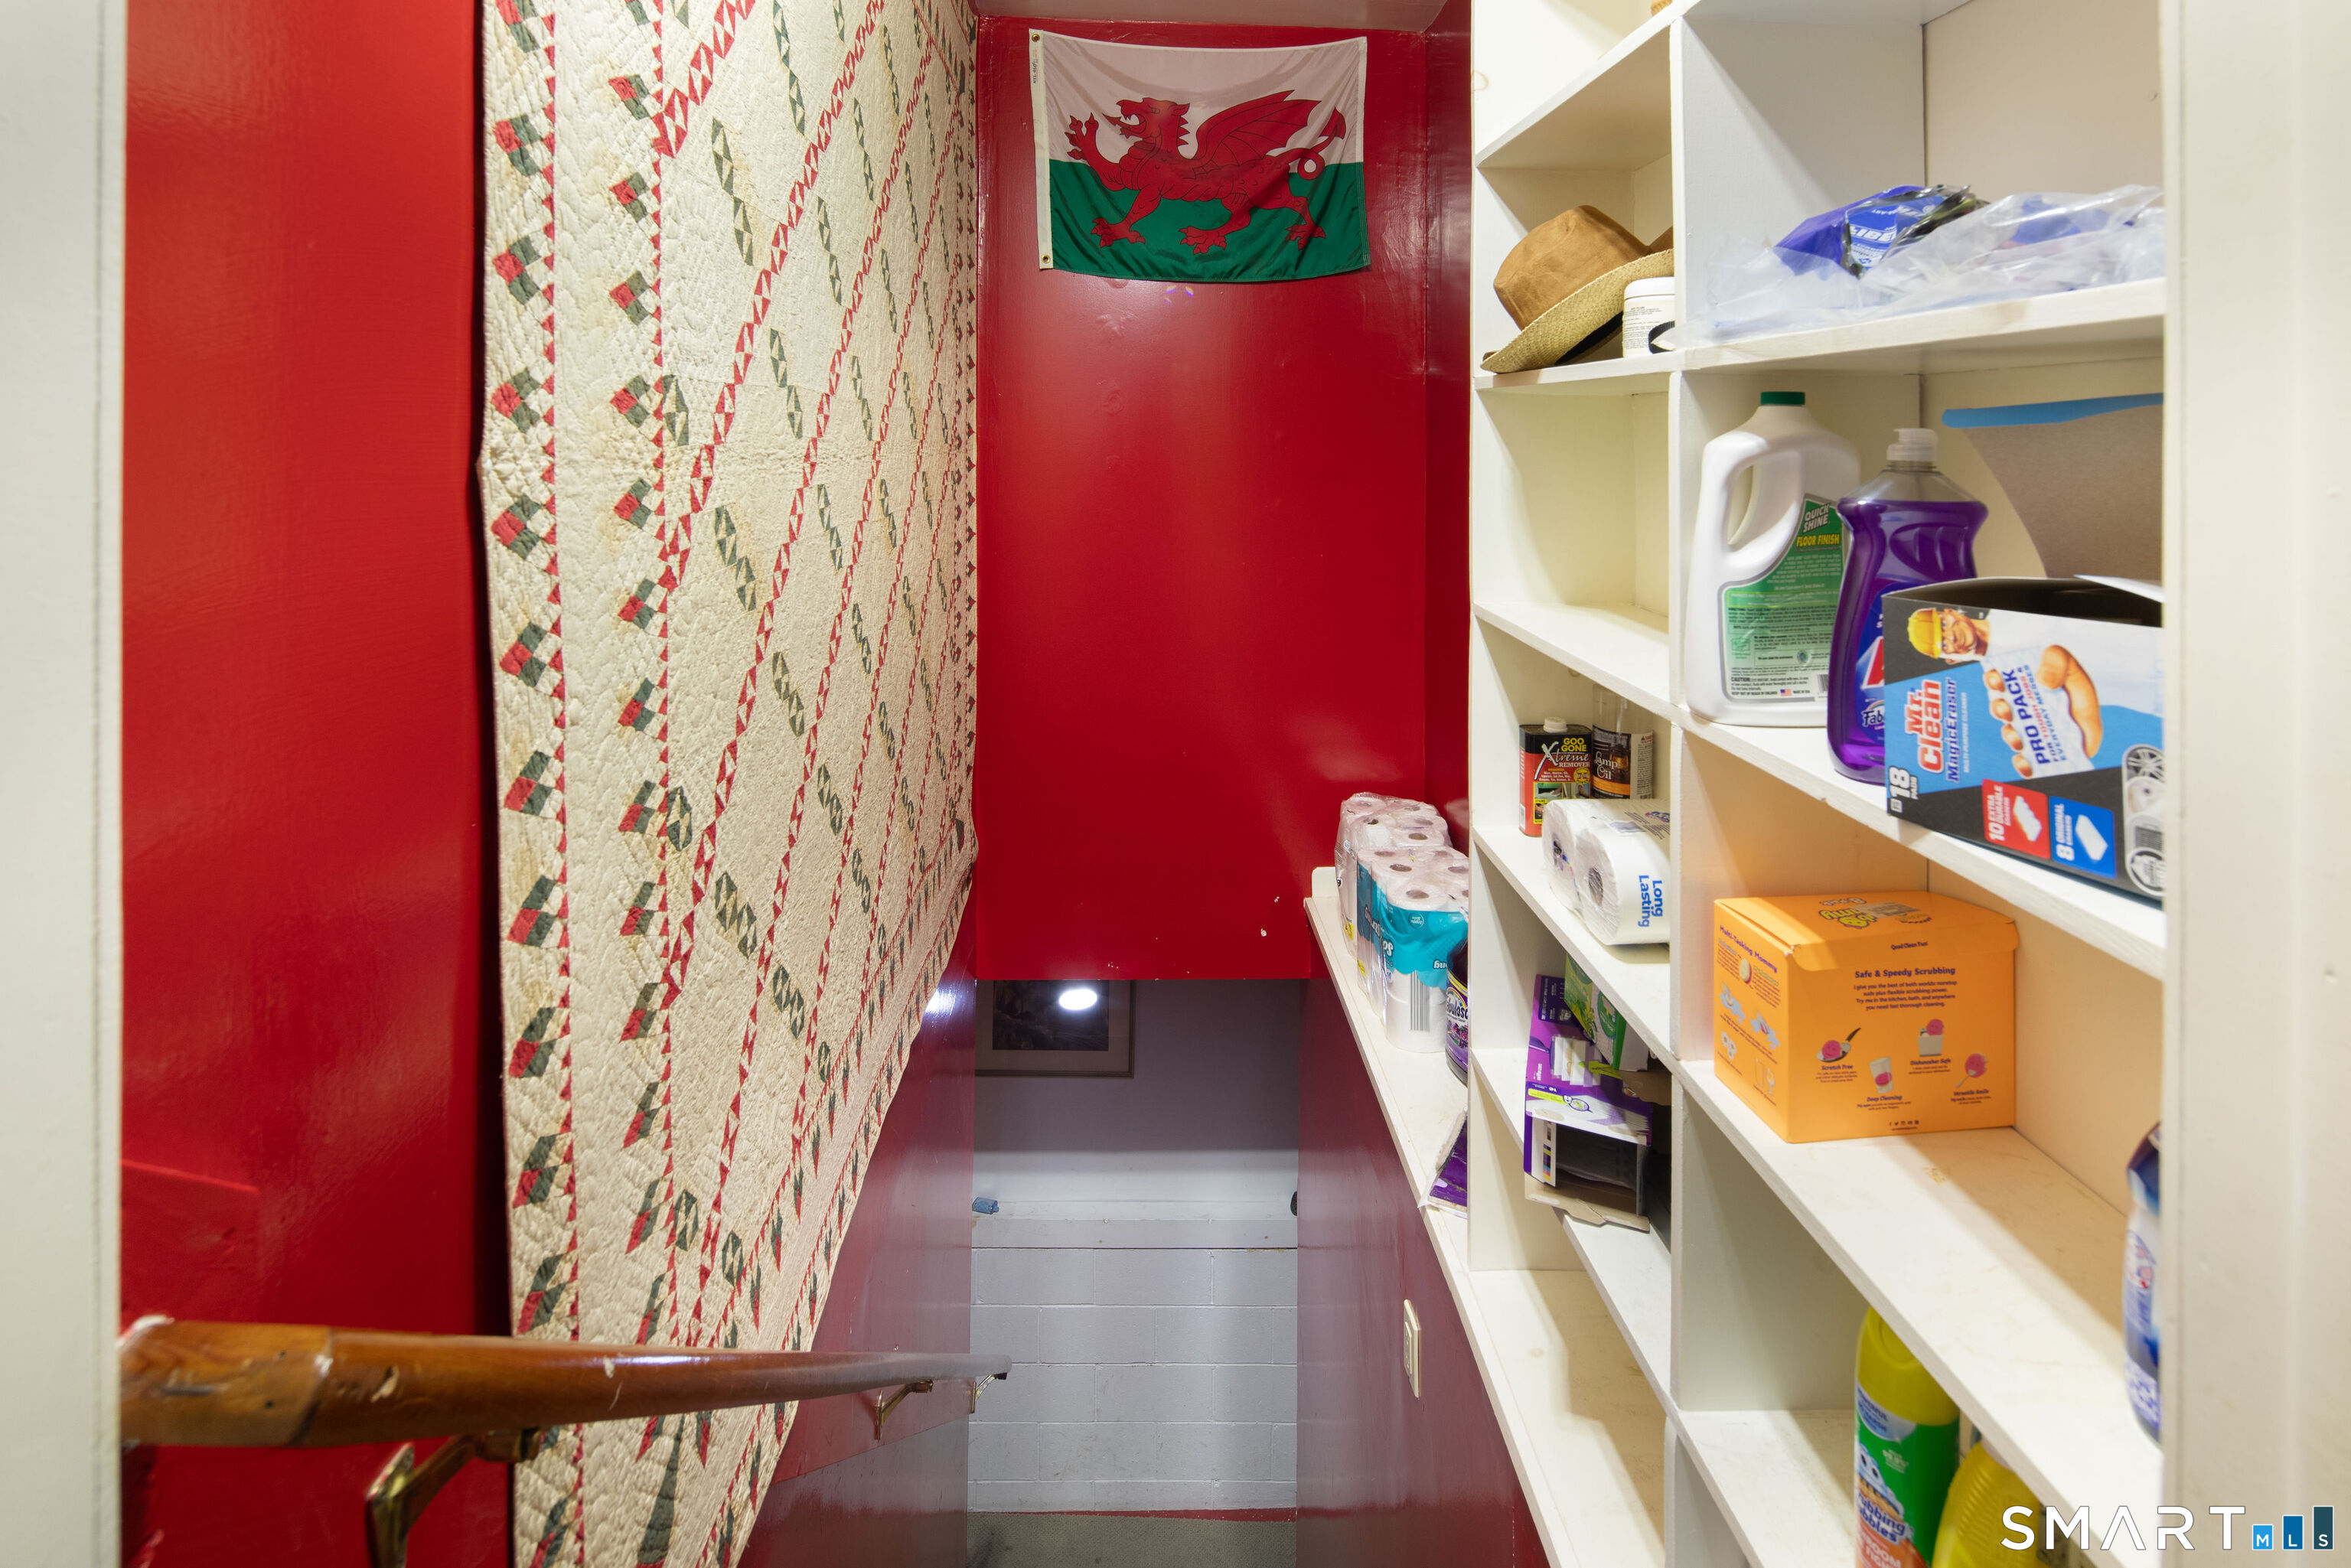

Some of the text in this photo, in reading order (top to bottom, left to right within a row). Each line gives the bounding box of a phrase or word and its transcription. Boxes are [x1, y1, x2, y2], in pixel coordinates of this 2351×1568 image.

[1803, 513, 1828, 533] SHINE
[1805, 503, 1831, 521] QUICK
[1796, 534, 1840, 547] FLOOR FINISH
[2020, 676, 2034, 703] JOBS
[1906, 691, 1924, 735] Mr.
[1919, 680, 1944, 773] Clean
[2003, 668, 2052, 764] PRO PACK
[2023, 664, 2066, 761] EVERYDAY MESSES
[2032, 704, 2049, 738] TOUGH
[1945, 677, 1960, 783] MagicEraser
[1534, 742, 1590, 781] Xtreme
[1594, 751, 1618, 770] Lamp
[1597, 764, 1612, 780] Oil
[1889, 766, 1911, 797] 18
[1910, 774, 1919, 800] PADS
[1989, 822, 2005, 841] 10
[2055, 804, 2065, 844] ORIGINAL
[2056, 844, 2075, 861] 8
[1638, 875, 1652, 927] Lasting
[1652, 880, 1663, 917] Long
[1720, 924, 1778, 973] Multi-Tasking Mommy
[1883, 969, 1912, 977] Speedy
[1915, 967, 1956, 975] Scrubbing
